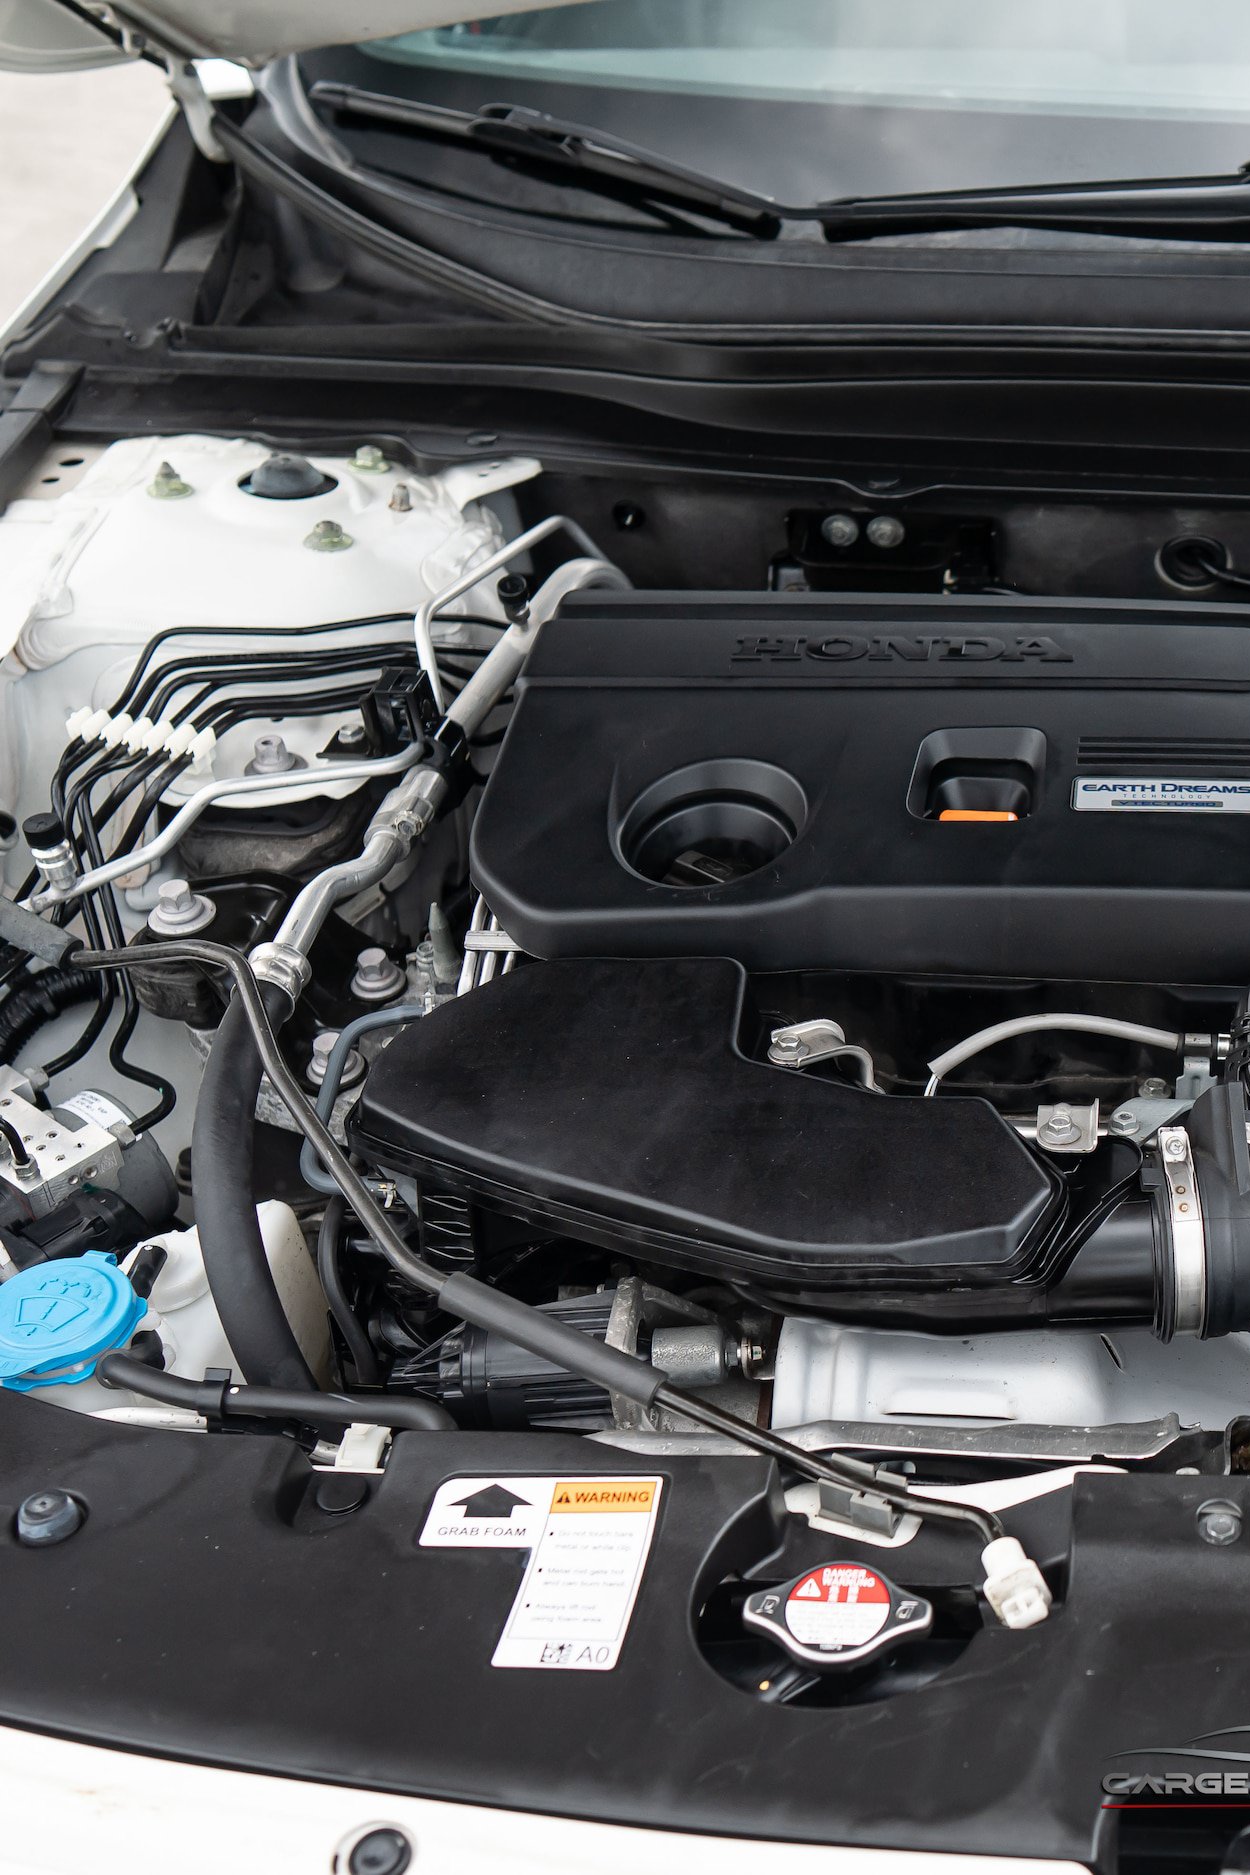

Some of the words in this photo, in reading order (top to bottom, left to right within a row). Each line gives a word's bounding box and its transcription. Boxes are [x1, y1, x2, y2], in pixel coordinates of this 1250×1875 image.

[731, 635, 1074, 662] HONDA
[1082, 783, 1155, 792] EARTH
[574, 1491, 650, 1504] WARNING
[437, 1526, 480, 1537] GRAB
[483, 1526, 527, 1537] FOAM
[822, 1576, 875, 1588] WARNING
